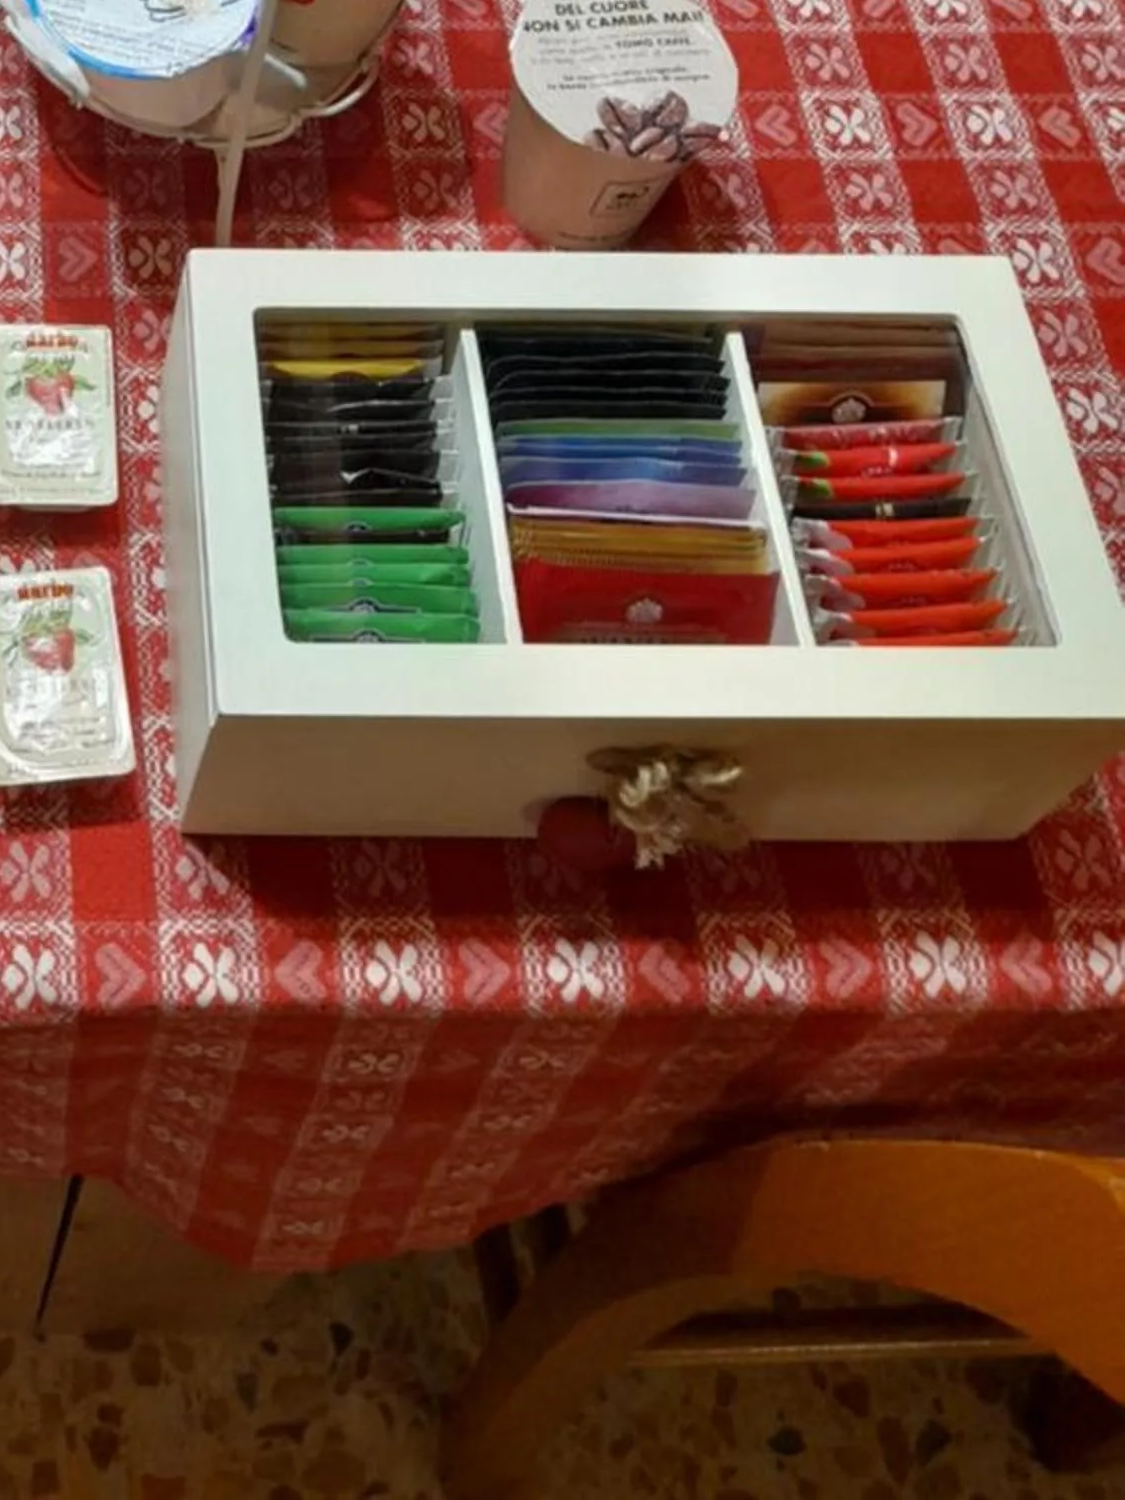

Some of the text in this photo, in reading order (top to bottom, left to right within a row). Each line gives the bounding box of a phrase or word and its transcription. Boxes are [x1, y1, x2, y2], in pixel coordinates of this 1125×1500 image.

[555, 0, 649, 16] DEL CUORE
[565, 19, 581, 32] SI
[586, 11, 659, 29] CAMBIA
